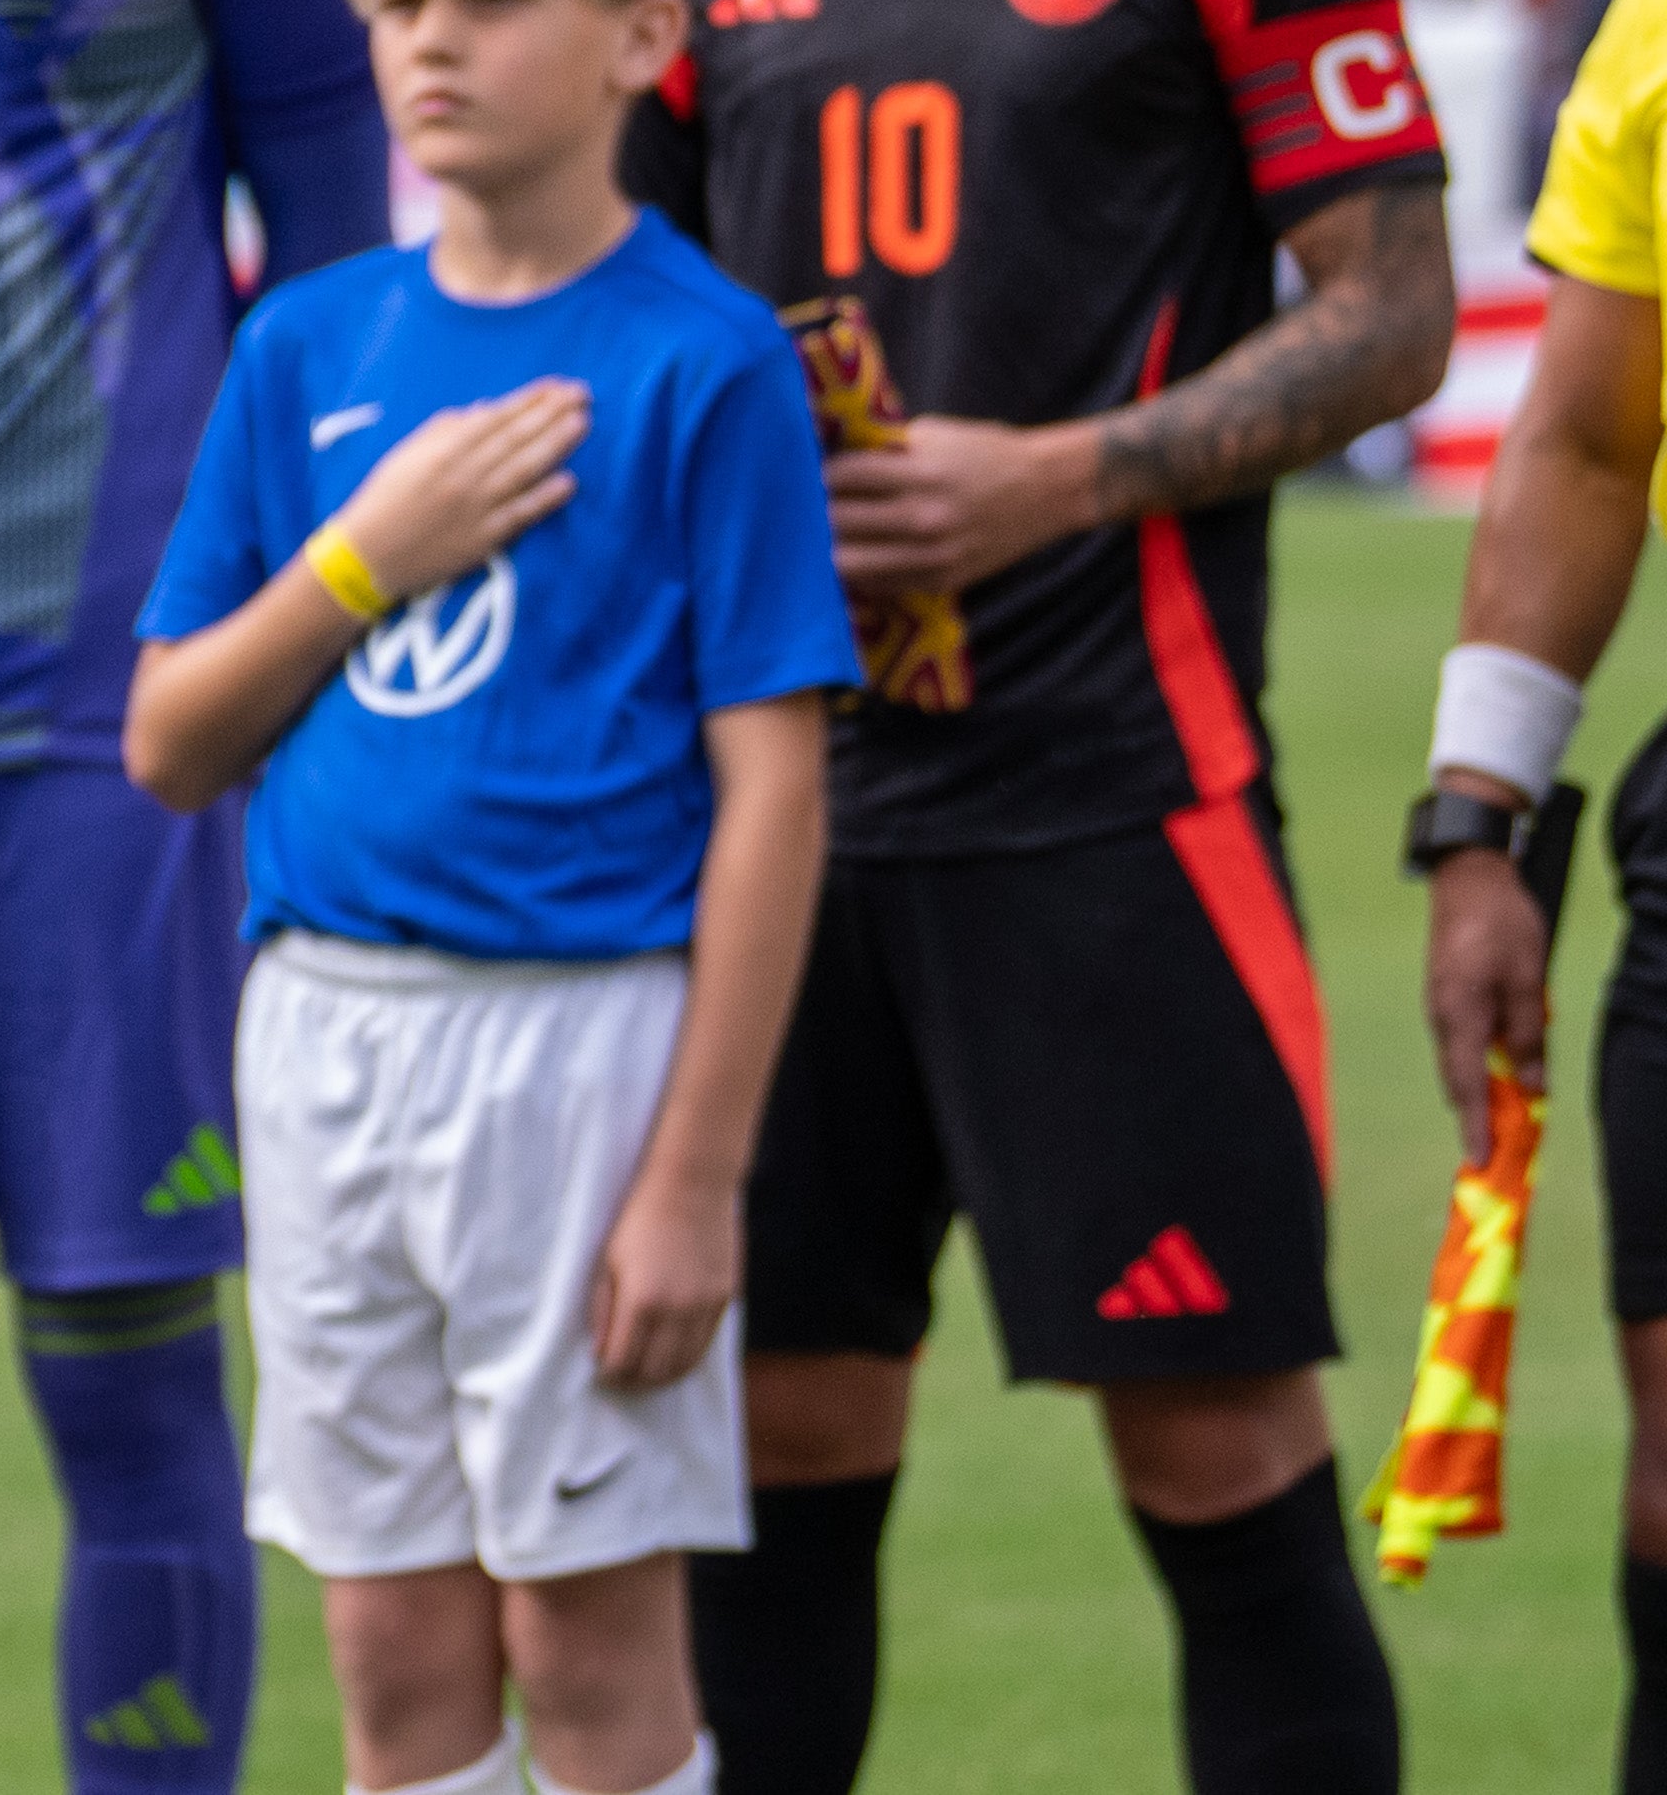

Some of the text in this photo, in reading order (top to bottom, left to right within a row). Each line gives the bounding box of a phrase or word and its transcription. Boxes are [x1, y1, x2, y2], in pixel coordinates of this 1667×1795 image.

[1310, 28, 1416, 142] C
[819, 80, 962, 278] 10
[355, 564, 514, 706] W
